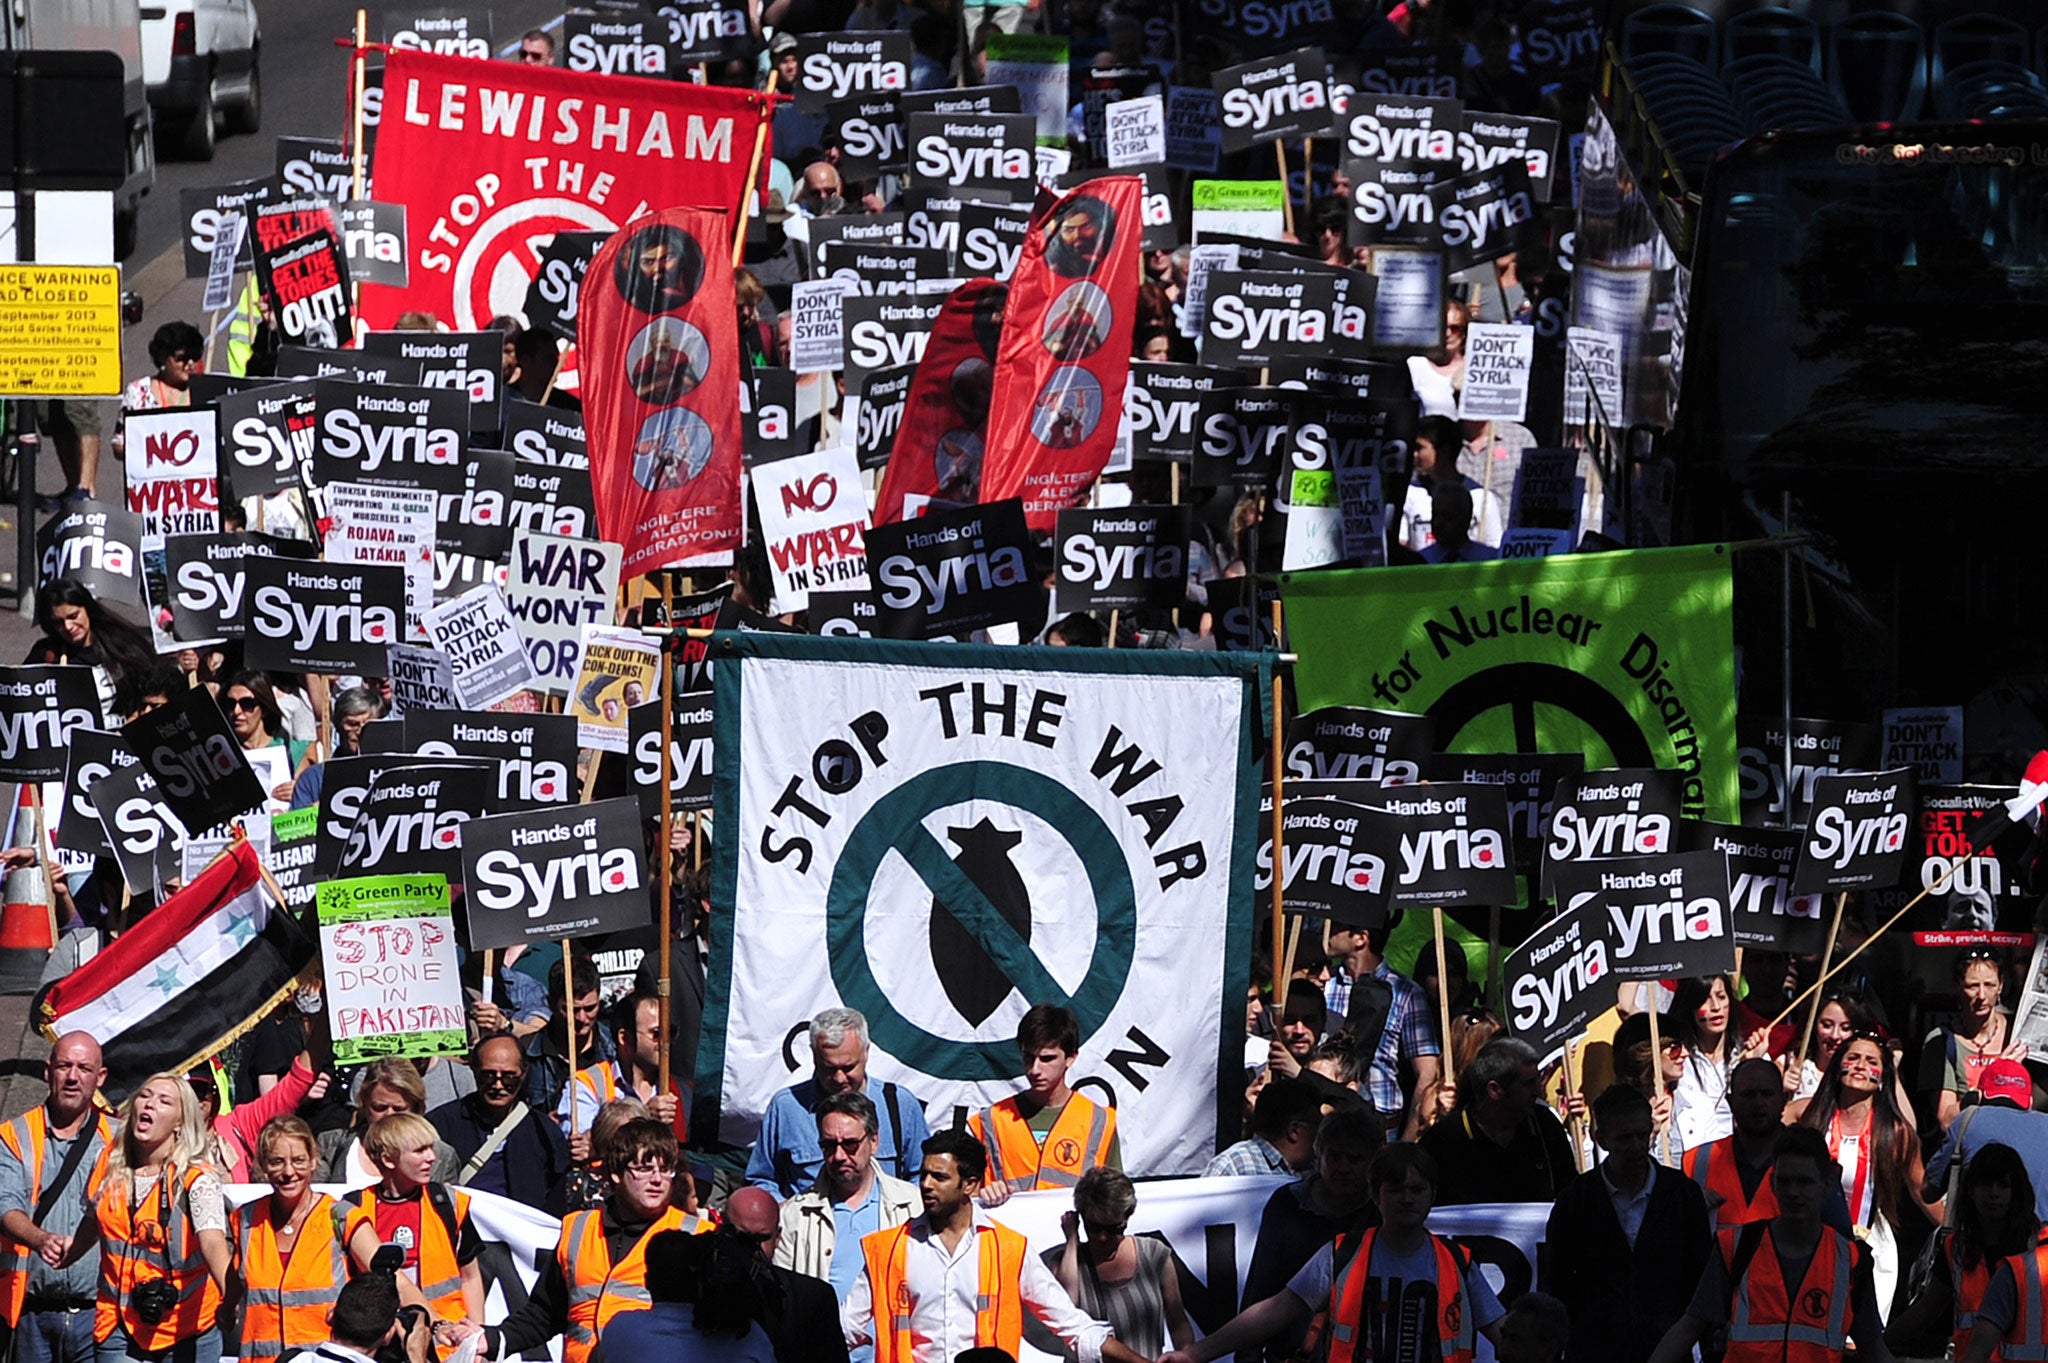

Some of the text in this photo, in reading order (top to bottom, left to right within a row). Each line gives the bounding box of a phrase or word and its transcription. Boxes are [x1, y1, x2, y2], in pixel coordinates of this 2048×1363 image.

[591, 22, 643, 36] Hands off
[568, 27, 666, 75] Syria
[827, 40, 883, 54] Hands off
[802, 53, 907, 98] Syria
[1241, 62, 1297, 85] Hands off
[1222, 75, 1326, 130] Syria
[1376, 104, 1434, 120] Hands off
[405, 78, 735, 163] LEWISHAM
[945, 124, 1005, 138] Hands off
[1111, 111, 1149, 129] DON'T
[1112, 123, 1160, 143] ATTACK
[1348, 114, 1454, 163] Syria
[1113, 139, 1149, 157] SYRIA
[915, 135, 1030, 185] Syria
[1217, 186, 1249, 197] Green
[421, 156, 616, 273] STOP THE
[1441, 191, 1534, 249] Syria
[271, 246, 336, 288] GET THE
[857, 255, 917, 270] Hands off
[35, 272, 112, 285] WARNING
[276, 267, 340, 308] TORIES
[1241, 281, 1304, 298] Hands off
[24, 289, 88, 302] CLOSED
[797, 292, 842, 310] DON'T
[66, 310, 96, 321] 2013
[282, 282, 347, 337] OUT!
[796, 307, 842, 325] ATTAC
[796, 322, 839, 339] SYRIA
[1210, 295, 1326, 350] Syria
[401, 342, 469, 359] Hands off
[1473, 338, 1517, 354] DON'T
[66, 355, 98, 366] 2013
[1470, 354, 1525, 369] ATTACK
[59, 368, 96, 378] Britain
[1147, 373, 1214, 391] Hands off
[1306, 367, 1371, 388] Hands off
[1468, 369, 1511, 385] SYRIA
[357, 395, 430, 414] Hands off
[146, 429, 199, 469] NO
[322, 409, 460, 471] Syria
[1291, 422, 1409, 474] Syria
[128, 477, 218, 514] WAR
[333, 486, 433, 502] TURKISH GOVERNMENT IS
[333, 497, 383, 510] SUPPORTING
[780, 472, 838, 518] NO
[86, 512, 108, 527] off
[161, 511, 215, 534] SYRIA
[352, 511, 412, 524] MURDERERS IN
[1093, 517, 1158, 534] Hands off
[346, 526, 416, 544] ROJAVA AND
[770, 519, 868, 573] WAR
[905, 519, 983, 550] Hands off
[1502, 541, 1553, 559] DON'T
[518, 538, 606, 596] WAR
[1060, 533, 1182, 591] Syria
[287, 572, 363, 591] Hands off
[788, 557, 868, 592] IN SYRIA
[878, 540, 1029, 615] Syria
[253, 585, 397, 651] Syria
[506, 592, 605, 626] WON'T
[434, 602, 490, 644] DON'T
[443, 614, 512, 657] ATTACK
[450, 639, 504, 676] SYRIA
[586, 643, 659, 667] KICK OUT THE
[1370, 650, 1421, 706] for
[1424, 595, 1602, 660] Nuclear
[290, 657, 357, 669] www.stopwar.org.uk
[392, 659, 437, 685] DON'T
[581, 658, 644, 679] CON-DEMS!
[394, 678, 450, 706] ATTACK
[454, 723, 534, 745] Hands off
[1315, 722, 1393, 743] Hands off
[1888, 724, 1945, 743] DON'T
[1887, 742, 1957, 762] ATTACK
[760, 681, 1208, 893] STOP THE WAR
[1463, 768, 1542, 785] Hands off
[371, 780, 441, 803] Hands off
[1577, 782, 1645, 802] Hands off
[1386, 796, 1468, 817] Hands off
[1282, 811, 1359, 834] Hands off
[1549, 800, 1673, 862] Syria
[1921, 810, 1967, 831] GET
[343, 800, 463, 868] Syria
[511, 818, 597, 847] Hands off
[1809, 804, 1908, 869] Syria
[1713, 836, 1794, 861] Hands off
[1253, 834, 1387, 895] Syria
[475, 839, 640, 919] Syria
[1601, 868, 1684, 891] Hands off
[353, 882, 445, 901] Green Party
[1396, 888, 1469, 901] www.stopwar.org.uk
[525, 915, 600, 936] www.stopwar.org.uk
[333, 921, 445, 964] STOP
[1530, 921, 1581, 968] Hands off
[1925, 934, 2023, 946] Strike, protest, occupy
[335, 962, 443, 991] DRONE
[1614, 961, 1684, 975] www.stopwar.org.uk
[382, 986, 407, 1004] IN
[1510, 938, 1610, 1031] Syria
[338, 1004, 464, 1039] PAKISTAN
